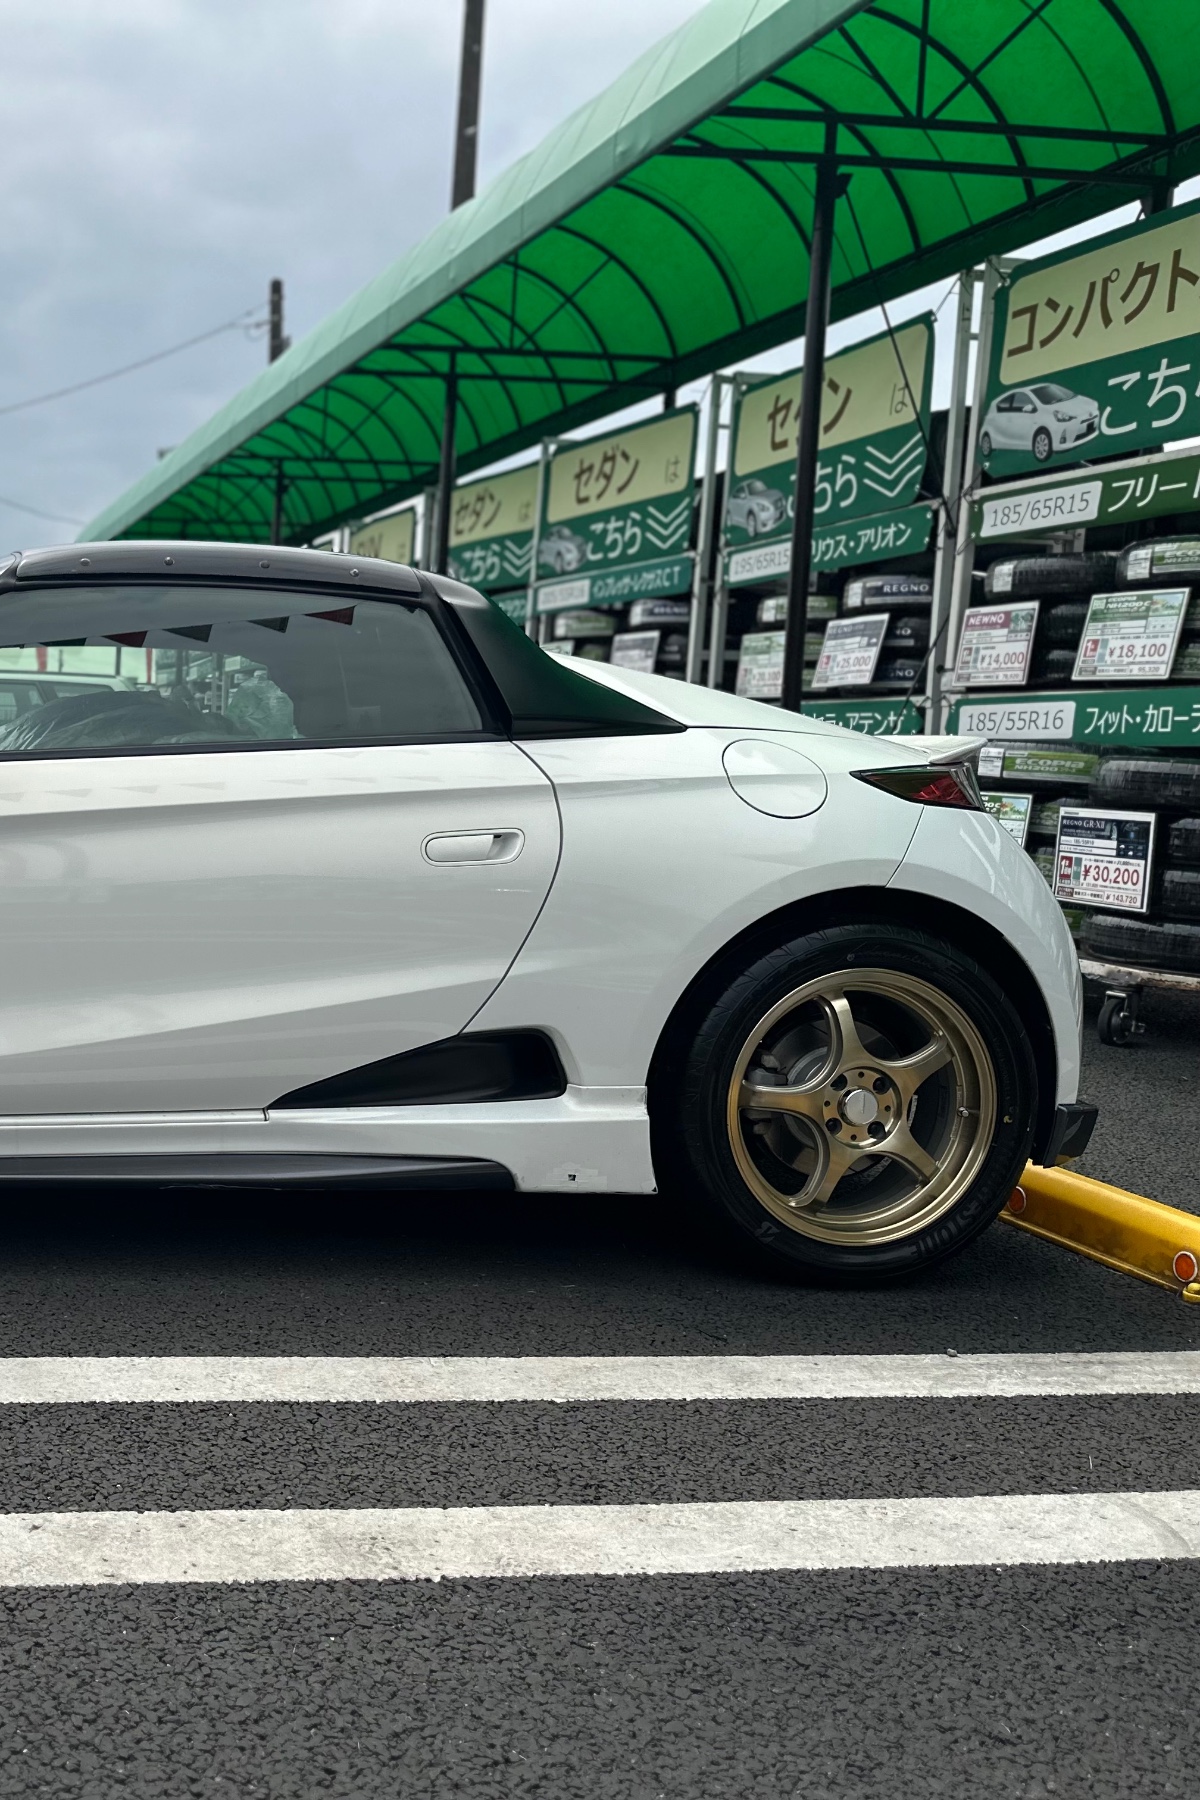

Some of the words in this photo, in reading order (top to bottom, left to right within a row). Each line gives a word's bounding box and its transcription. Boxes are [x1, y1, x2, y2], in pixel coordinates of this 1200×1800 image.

[1007, 248, 1200, 358] コンパクト
[889, 381, 909, 417] は
[1100, 358, 1200, 436] こち
[573, 444, 640, 506] セダン
[455, 487, 502, 536] セダン
[990, 491, 1092, 528] 185/65R15
[586, 511, 642, 561] こちら
[811, 522, 913, 563] リウス・アリオン
[459, 543, 501, 583] こちら
[883, 583, 930, 593] REGNO
[968, 613, 1005, 626] NEWNO
[980, 651, 1025, 668] ¥14,000
[1108, 643, 1167, 660] ¥18,100
[966, 708, 1064, 735] 185/55R16
[1082, 864, 1140, 886] ¥30,200
[1112, 894, 1138, 904] 143,720
